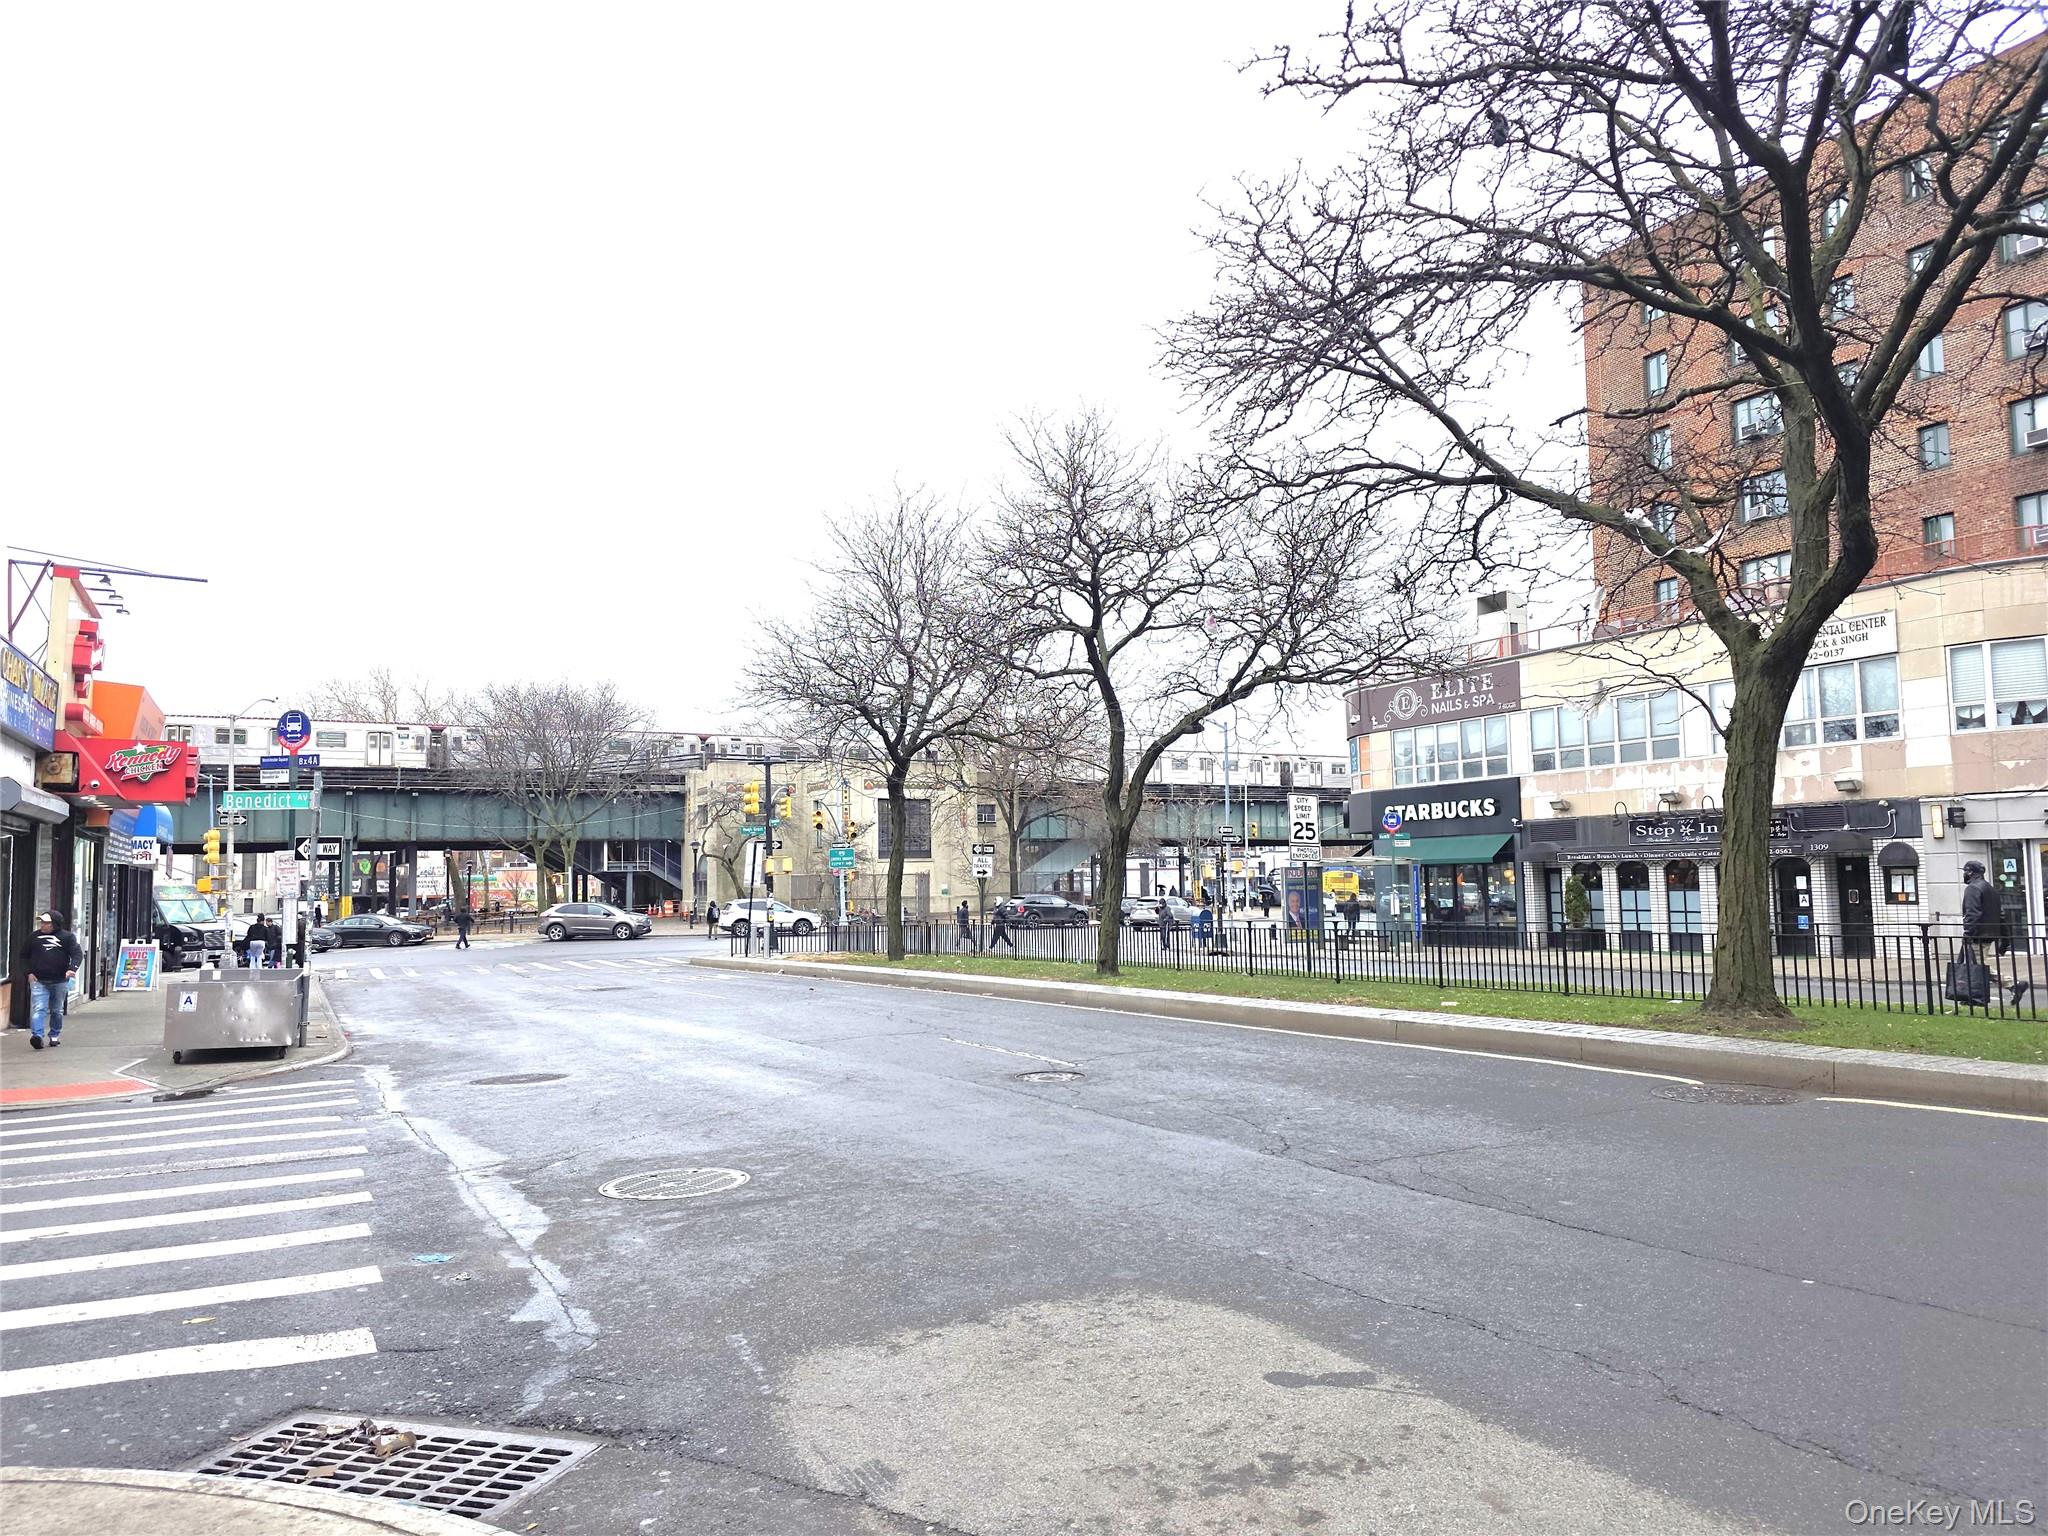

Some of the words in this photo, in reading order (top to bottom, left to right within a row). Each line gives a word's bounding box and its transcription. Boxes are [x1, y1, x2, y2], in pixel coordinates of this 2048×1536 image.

[1818, 624, 1846, 638] ENTAL
[1849, 616, 1887, 632] CENTER
[1812, 639, 1829, 649] OCK
[1832, 638, 1837, 646] &
[1841, 632, 1868, 644] SINGH
[1808, 648, 1844, 660] 92-0137
[1430, 673, 1494, 700] ELITE
[1431, 698, 1462, 714] NAILS
[1464, 700, 1470, 708] &
[1472, 693, 1494, 707] SPA
[105, 746, 182, 772] Kennedy
[298, 756, 318, 765] Bx4A
[124, 762, 164, 775] CHICKEN
[226, 794, 292, 808] Benedict
[1293, 822, 1316, 840] 25
[1636, 824, 1675, 838] Step
[1698, 823, 1719, 834] In
[323, 844, 337, 854] WAY
[2006, 861, 2014, 869] A
[128, 951, 148, 959] WIC
[184, 996, 192, 1005] A
